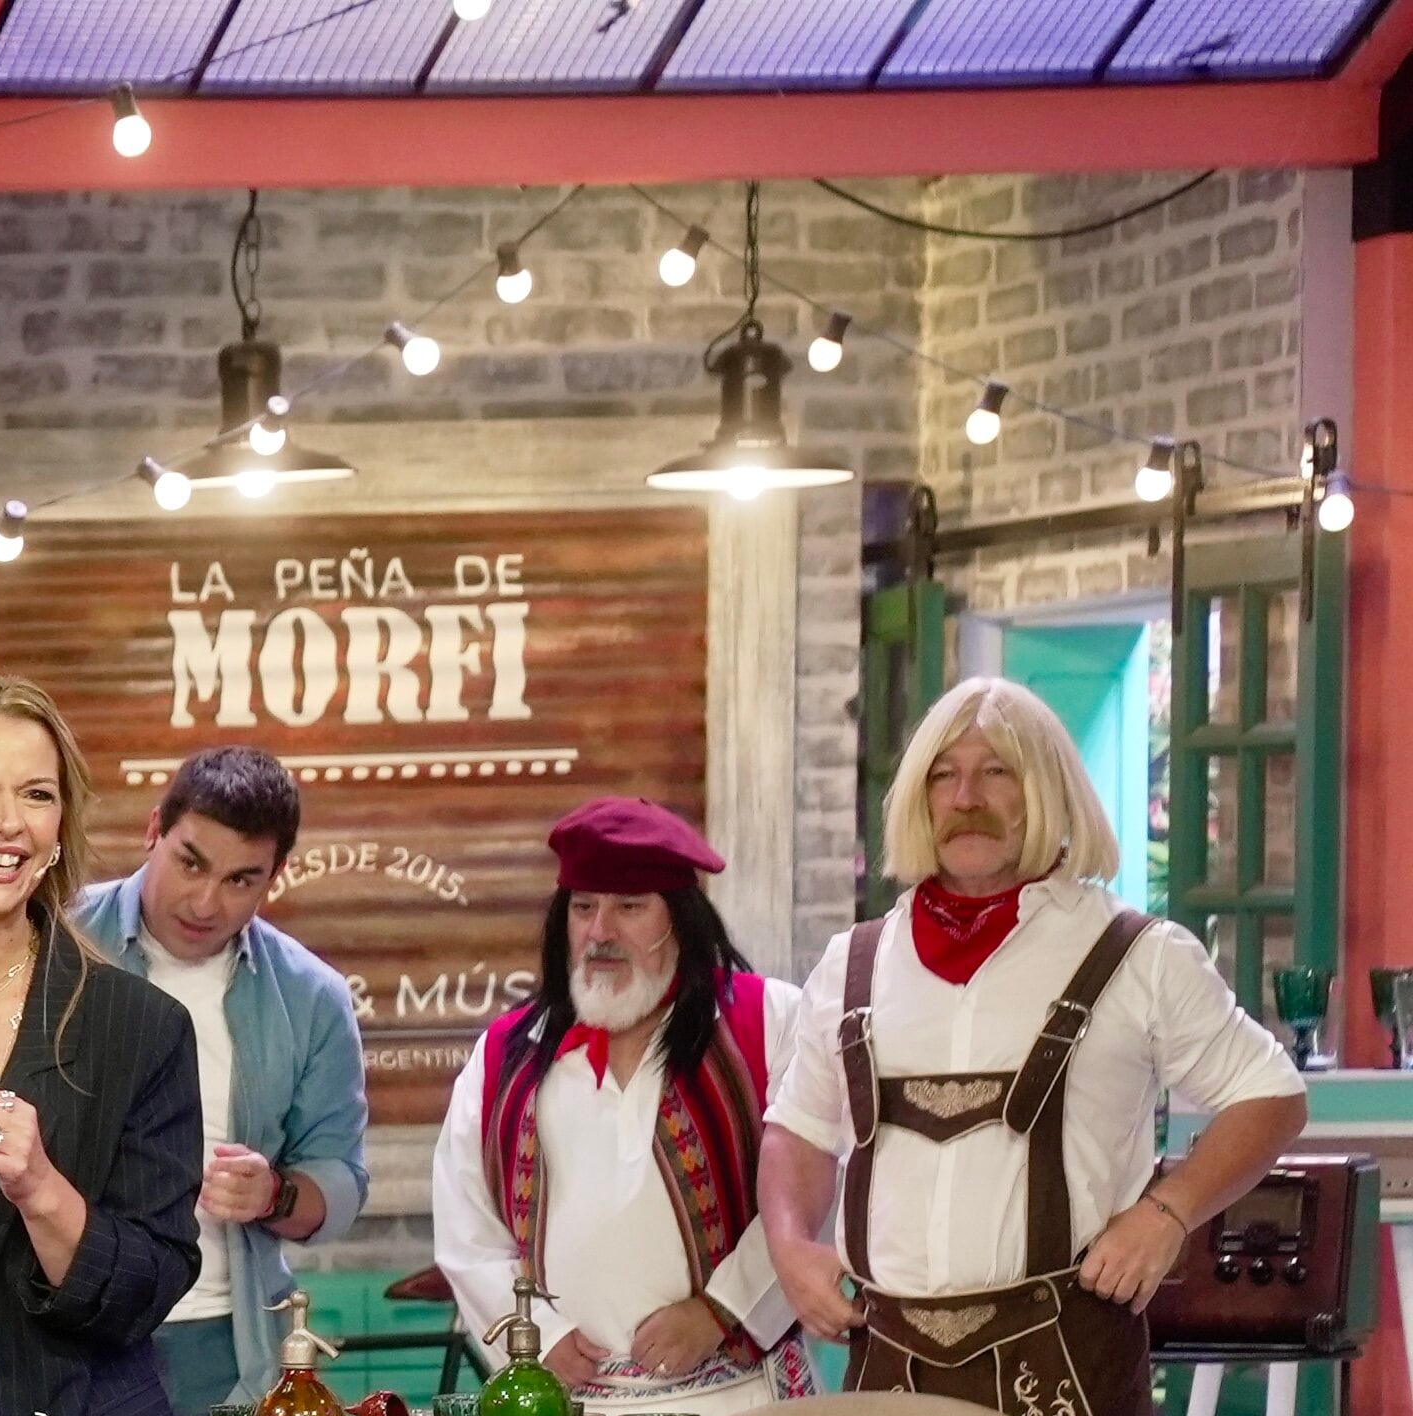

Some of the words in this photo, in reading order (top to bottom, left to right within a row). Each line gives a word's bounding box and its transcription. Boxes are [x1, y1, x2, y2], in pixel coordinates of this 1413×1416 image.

[170, 560, 235, 602] LA
[275, 548, 414, 600] PEÑA
[454, 554, 524, 598] DE
[167, 602, 532, 728] MORFI
[346, 973, 375, 1019] &
